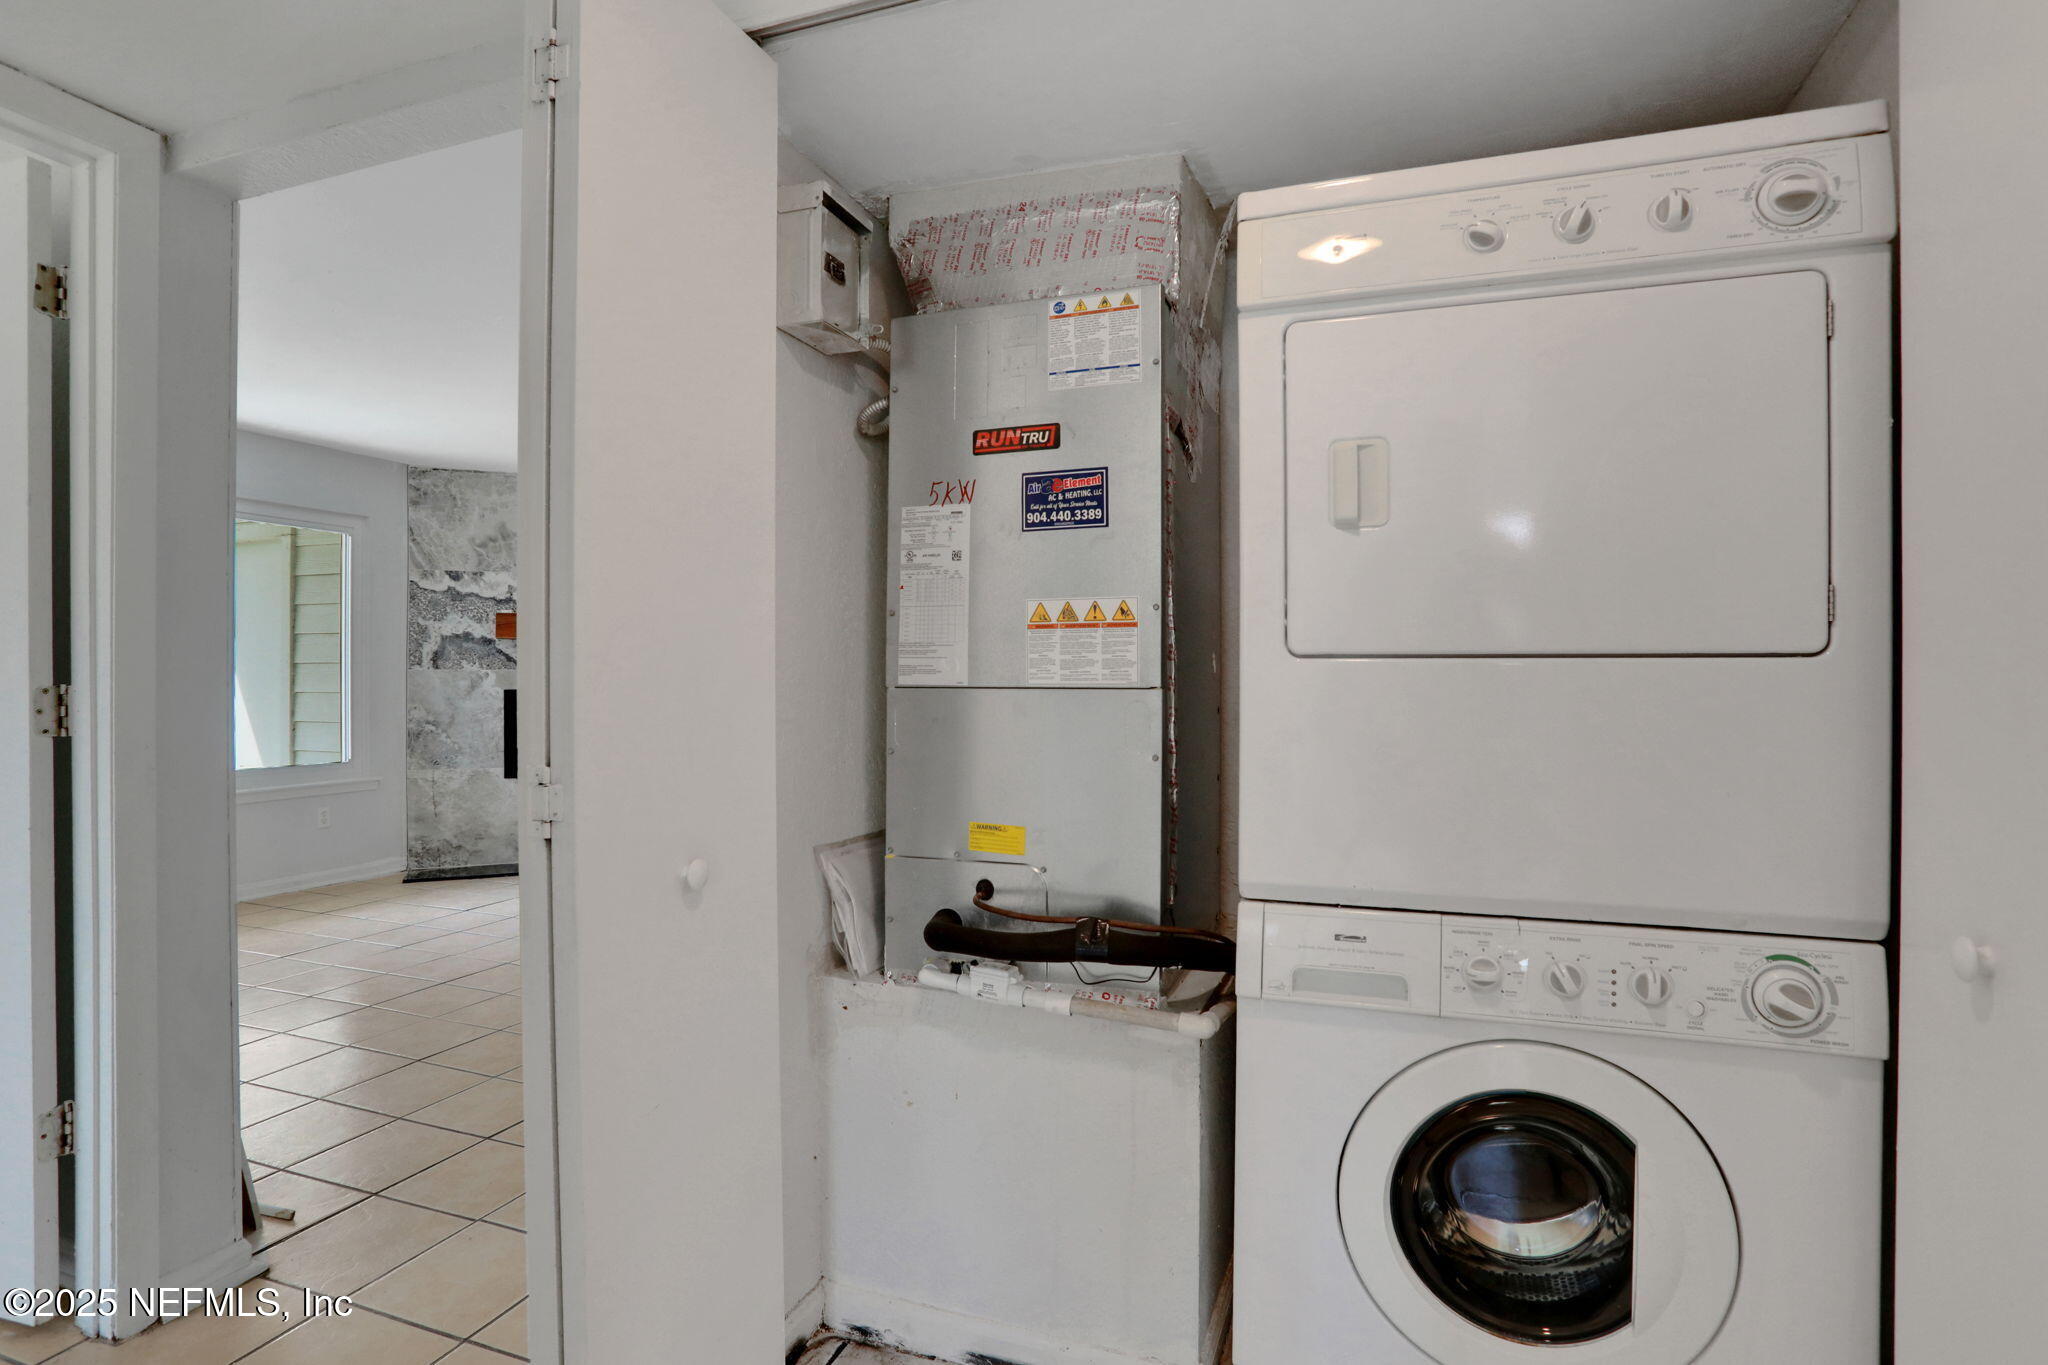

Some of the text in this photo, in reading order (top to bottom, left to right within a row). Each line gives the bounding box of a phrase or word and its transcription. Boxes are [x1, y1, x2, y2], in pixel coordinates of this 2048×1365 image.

[1027, 482, 1041, 494] Air
[1063, 474, 1102, 489] Element
[1048, 493, 1057, 501] AC
[1093, 488, 1103, 496] LLC
[1026, 508, 1103, 524] 904.440.3389
[976, 824, 1003, 832] WARNING
